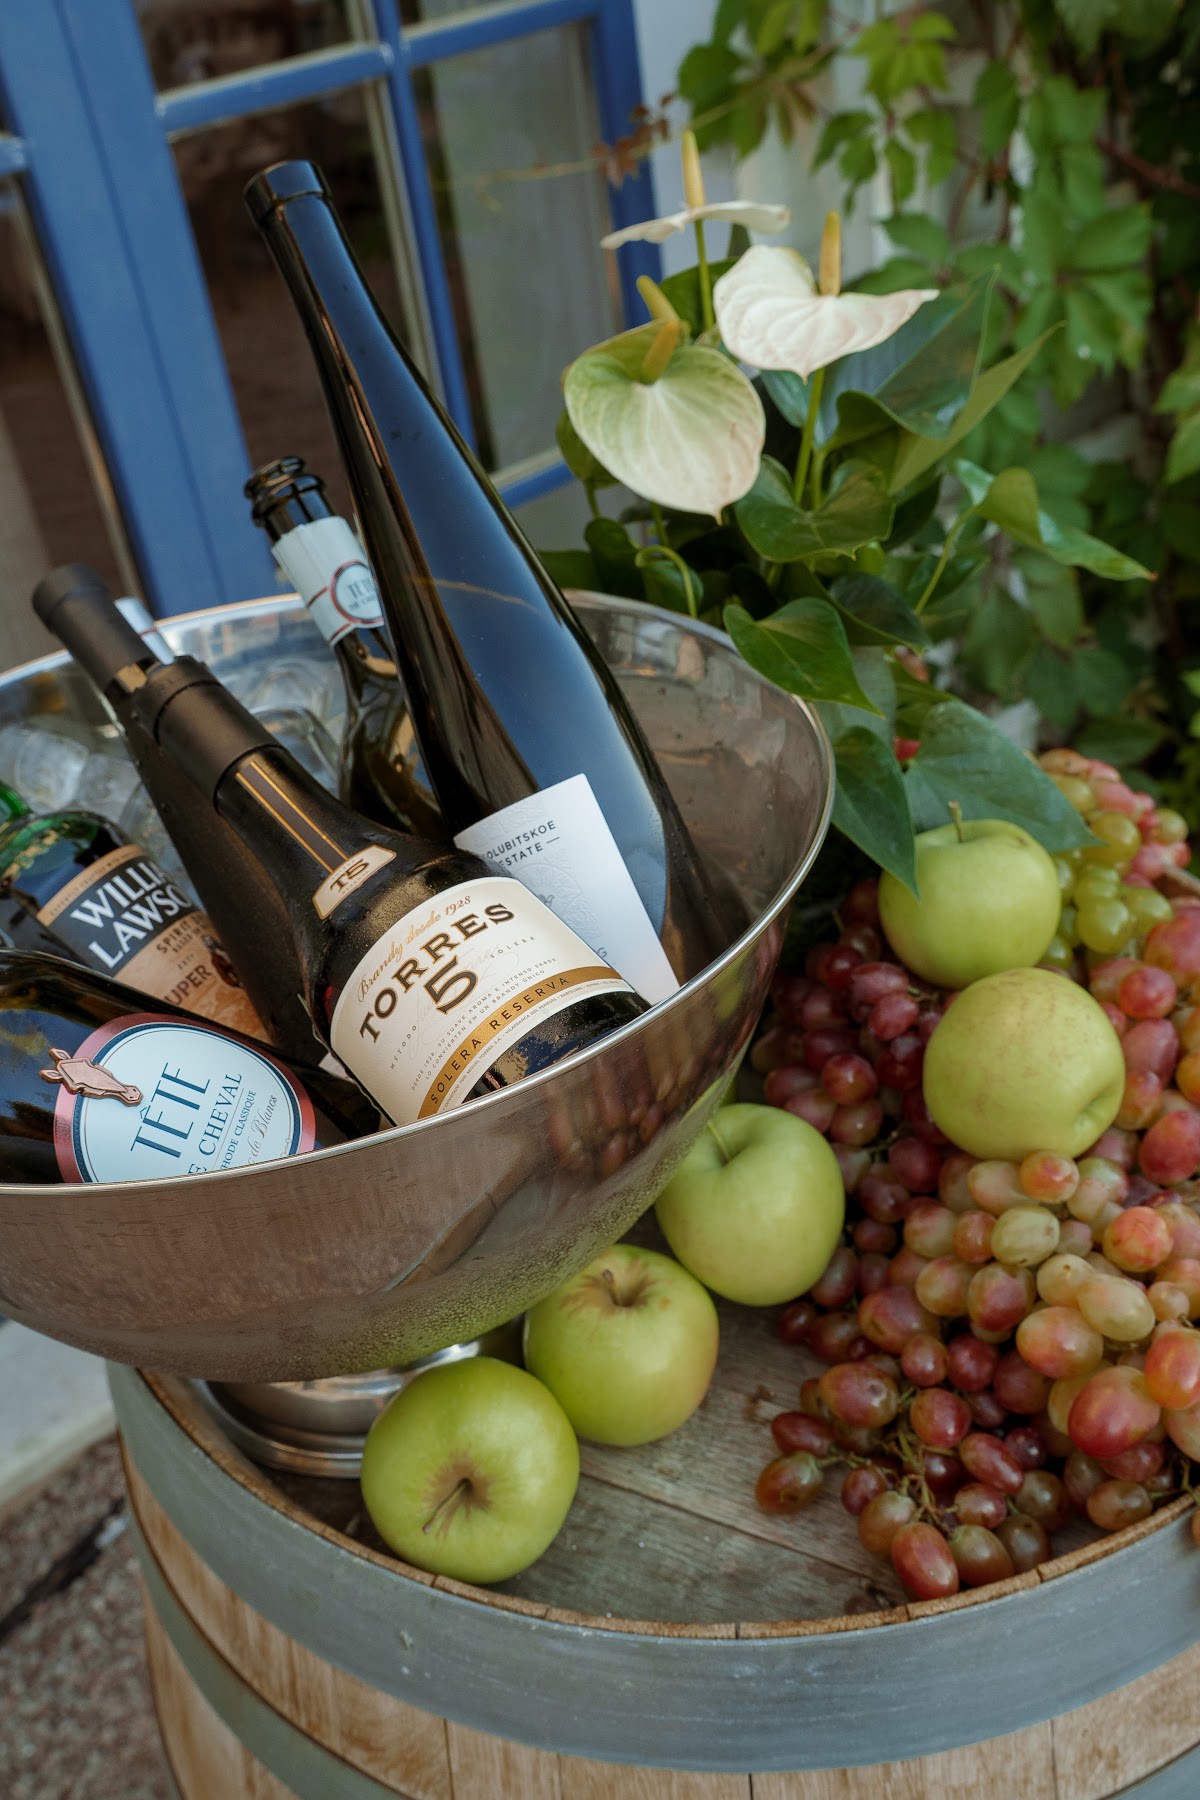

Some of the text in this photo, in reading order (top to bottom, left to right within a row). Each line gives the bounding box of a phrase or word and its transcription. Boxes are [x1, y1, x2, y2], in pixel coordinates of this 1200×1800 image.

[329, 858, 370, 893] T5
[486, 820, 556, 859] OLUBITSKOE
[88, 884, 191, 968] LAWSO
[357, 895, 471, 1003] Brandy desde 1928
[490, 936, 535, 959] SOLERA
[164, 965, 212, 1005] UPER
[359, 903, 515, 1043] TORRES
[422, 954, 479, 1016] 5
[411, 1068, 424, 1091] DESDE
[446, 1015, 466, 1036] SUAVE
[468, 993, 493, 1014] AROMA
[501, 967, 532, 987] INTENSO
[534, 957, 557, 968] SABOR
[425, 1070, 432, 1080] LO
[432, 1026, 466, 1069] CONVIERTEN
[468, 1015, 478, 1025] EN
[480, 1005, 490, 1014] UN
[491, 982, 520, 1004] BRANDY
[431, 977, 569, 1104] SOLERA RESERVA
[130, 1062, 210, 1158] TÊTE
[198, 1073, 243, 1156] CHEVAL
[221, 1138, 239, 1169] HODE
[235, 1090, 256, 1137] CLASSIQUE
[247, 1095, 278, 1157] de Blancs
